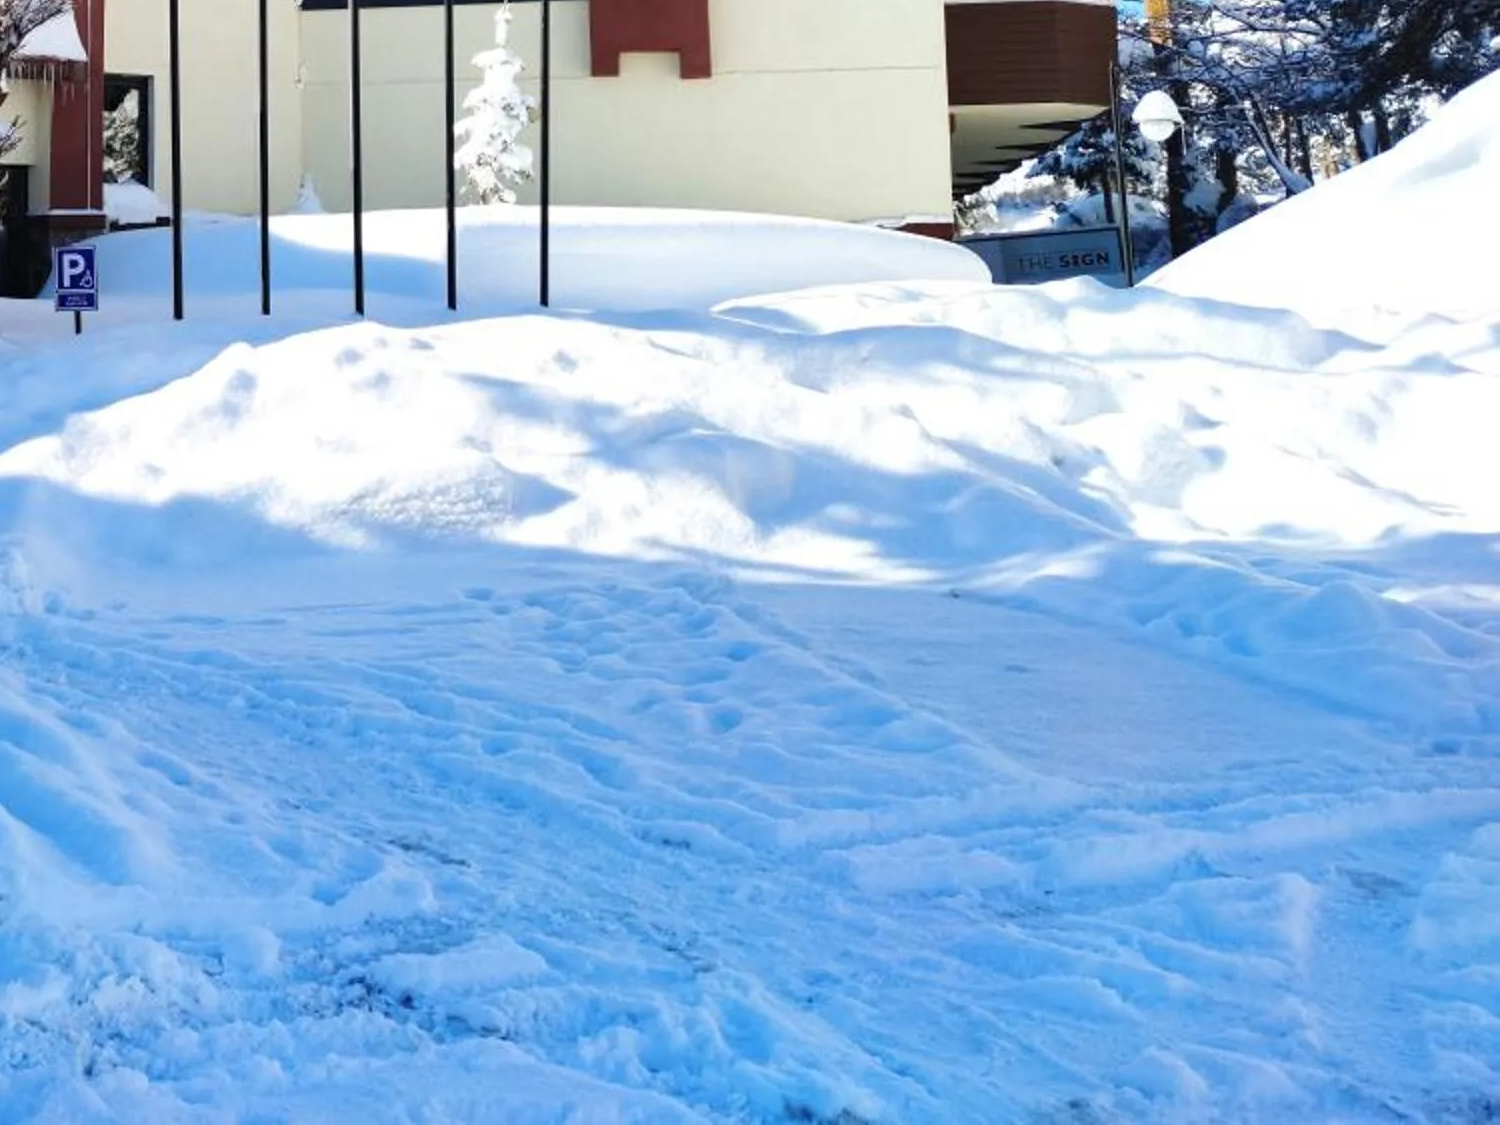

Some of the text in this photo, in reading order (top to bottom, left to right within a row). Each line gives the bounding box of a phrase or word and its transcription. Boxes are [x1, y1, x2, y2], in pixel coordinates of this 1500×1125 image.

[63, 253, 85, 288] P
[1017, 251, 1109, 271] THE SIGN
